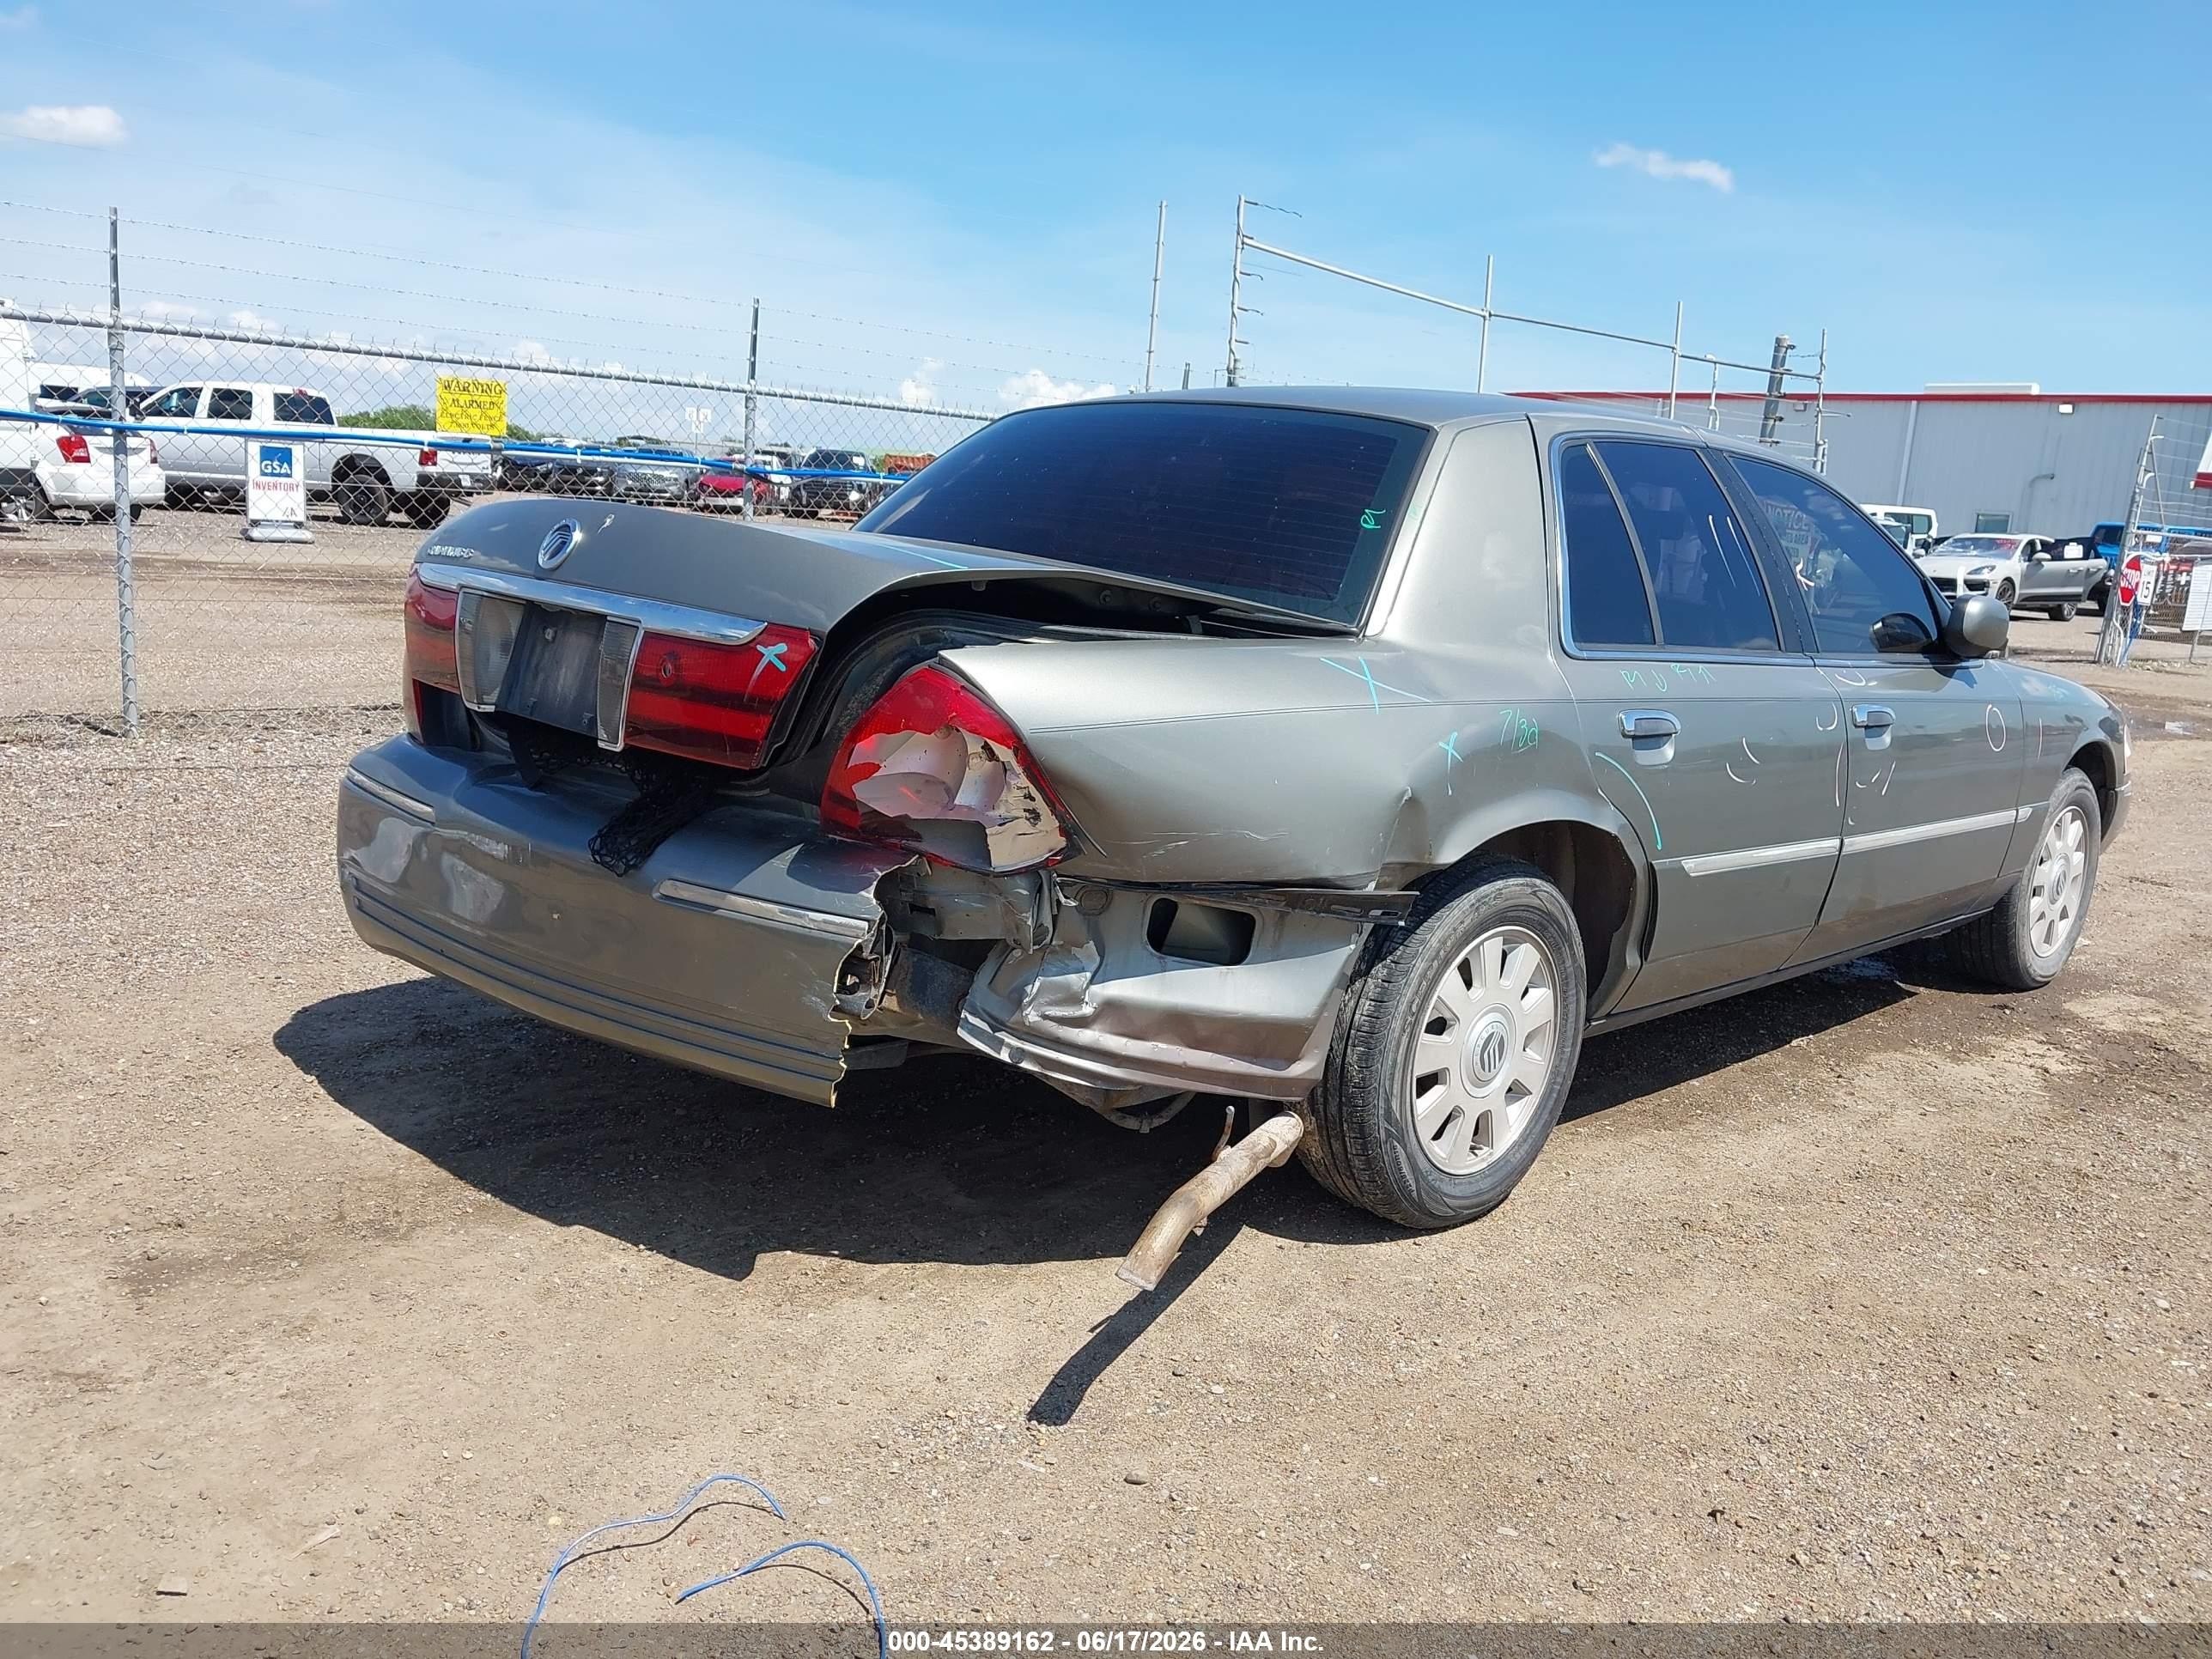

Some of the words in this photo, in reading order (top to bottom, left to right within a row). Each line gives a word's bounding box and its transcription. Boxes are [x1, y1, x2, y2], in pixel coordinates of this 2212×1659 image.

[443, 379, 502, 395] WARNING
[449, 398, 495, 410] ALARMED
[261, 460, 291, 474] GSA
[252, 480, 300, 492] INVENTORY
[2120, 568, 2141, 590] STOP
[2141, 580, 2151, 599] 15
